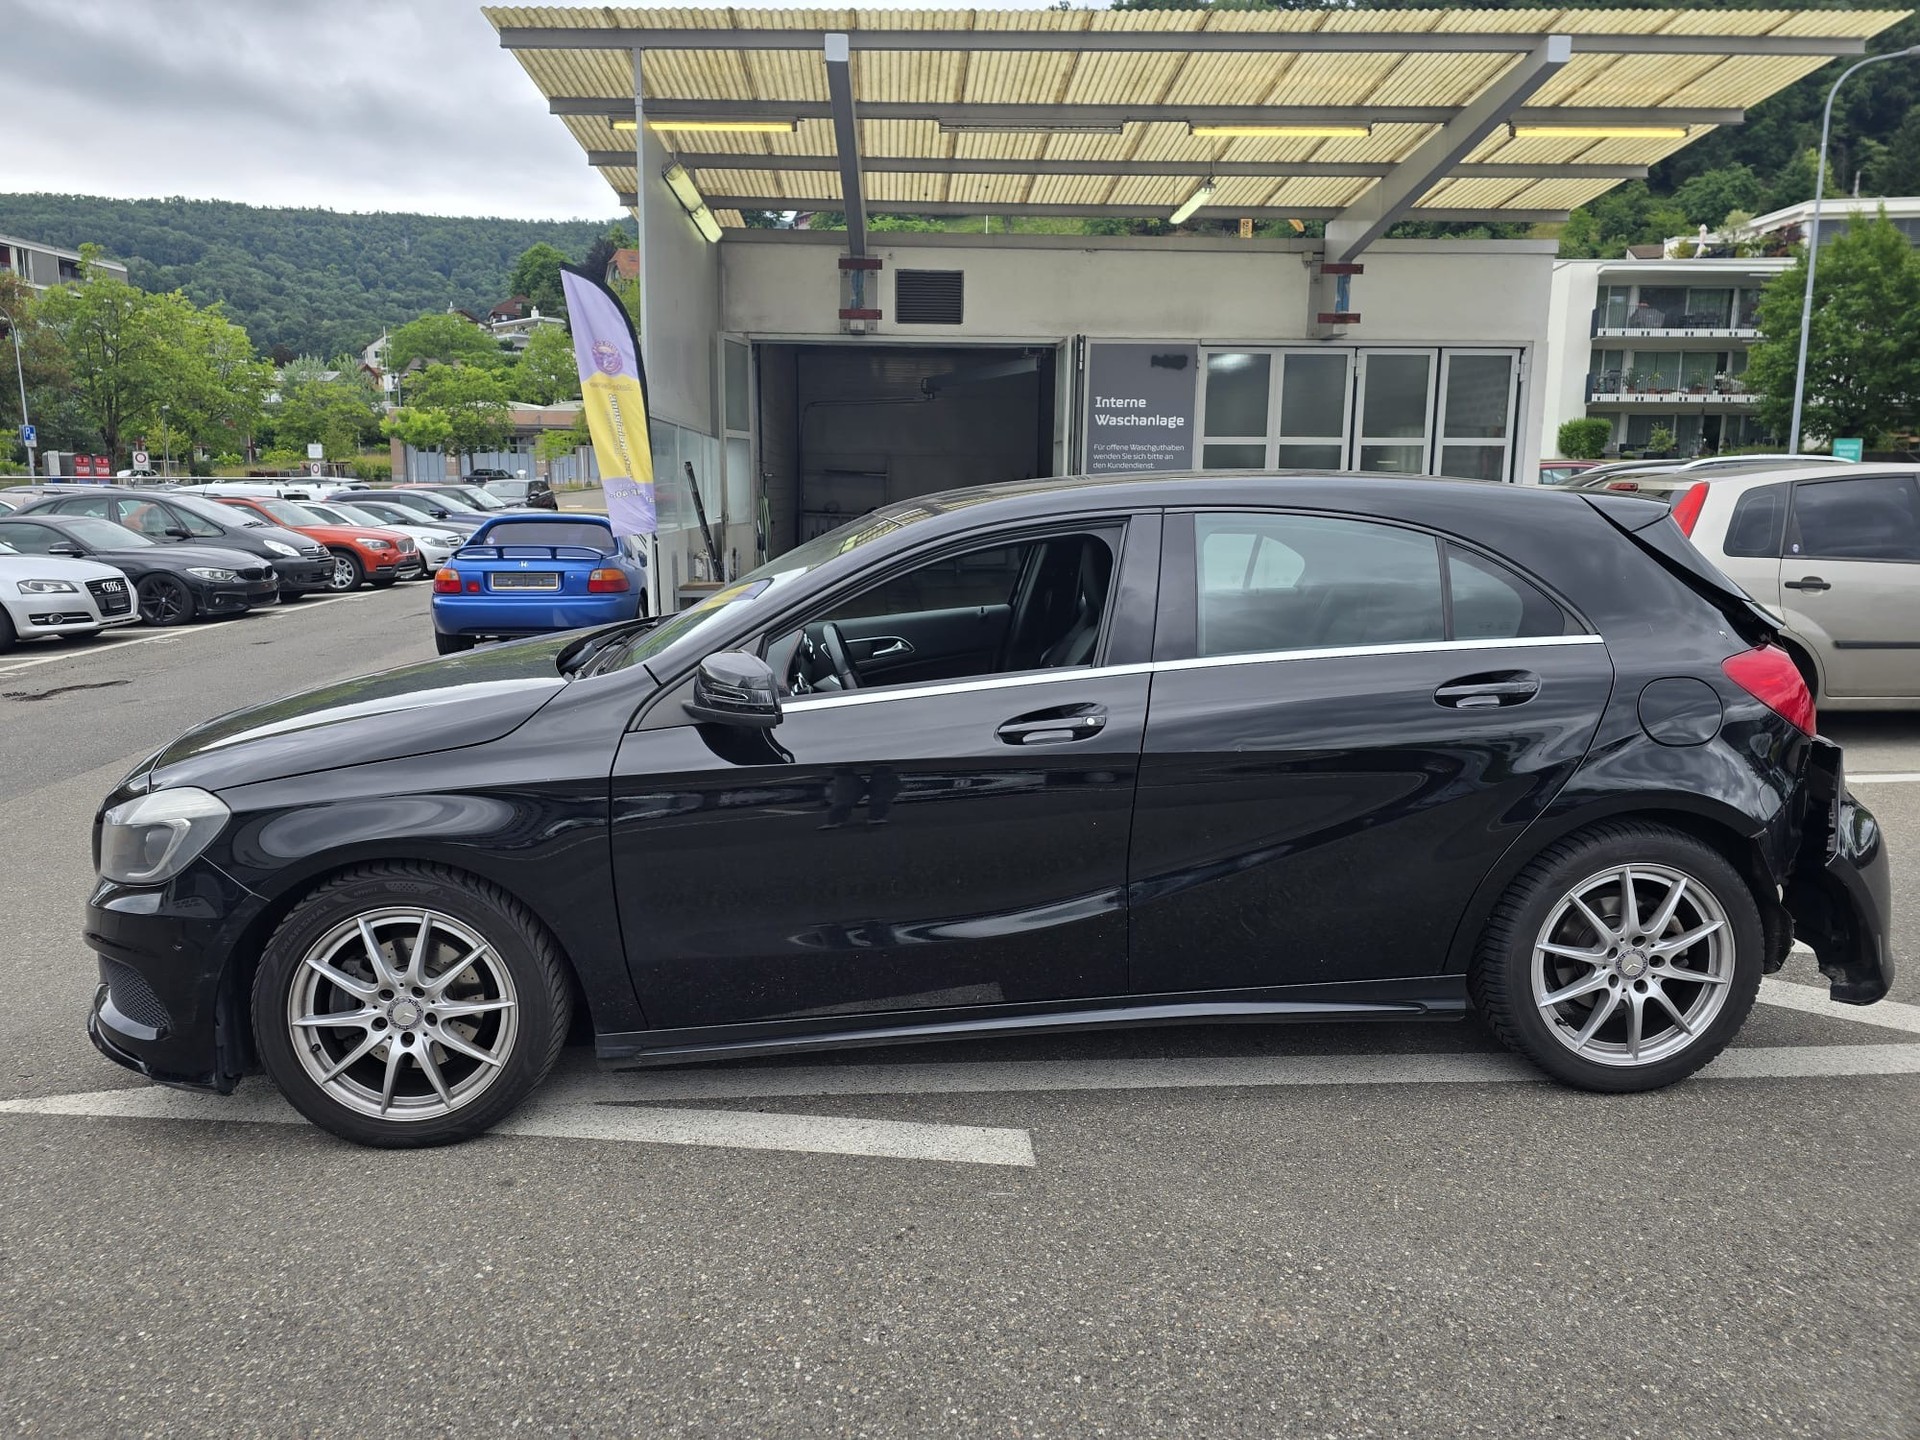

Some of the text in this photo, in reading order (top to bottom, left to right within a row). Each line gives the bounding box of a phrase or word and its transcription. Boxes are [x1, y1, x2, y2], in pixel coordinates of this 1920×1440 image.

[1095, 396, 1147, 408] Interne
[1094, 414, 1185, 429] Waschanlage
[1093, 443, 1185, 452] Für offene Waschguthaben
